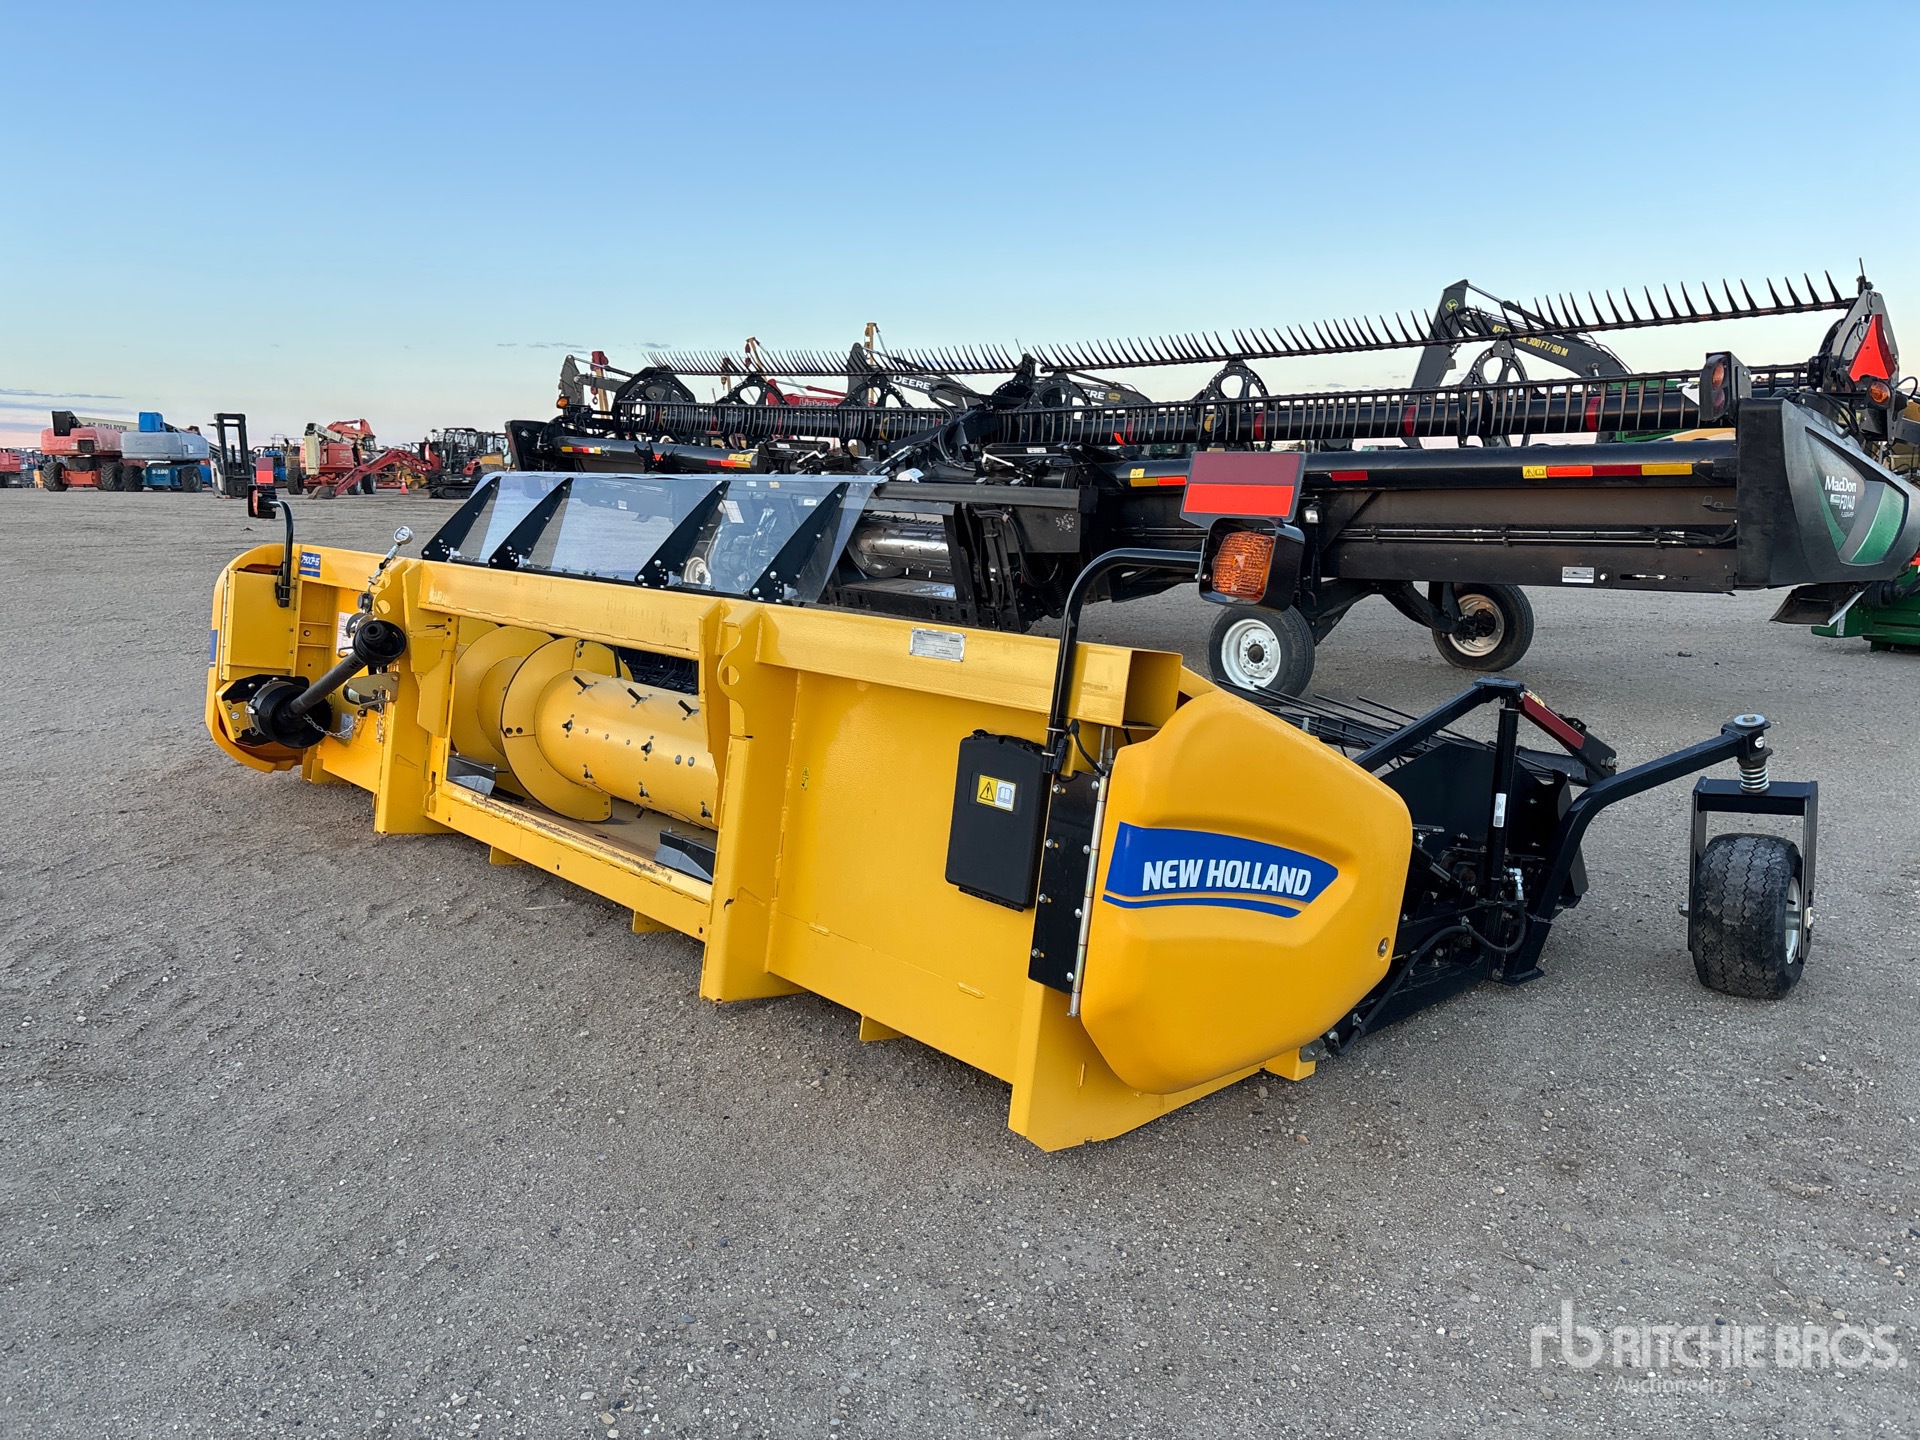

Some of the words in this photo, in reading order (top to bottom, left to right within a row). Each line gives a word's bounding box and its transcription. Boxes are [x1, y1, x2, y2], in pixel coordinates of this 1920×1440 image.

[1528, 337, 1541, 348] 300
[892, 375, 931, 391] DEERE
[1824, 475, 1857, 493] MacDon
[1142, 859, 1204, 892] NEW
[1205, 859, 1312, 897] HOLLAND
